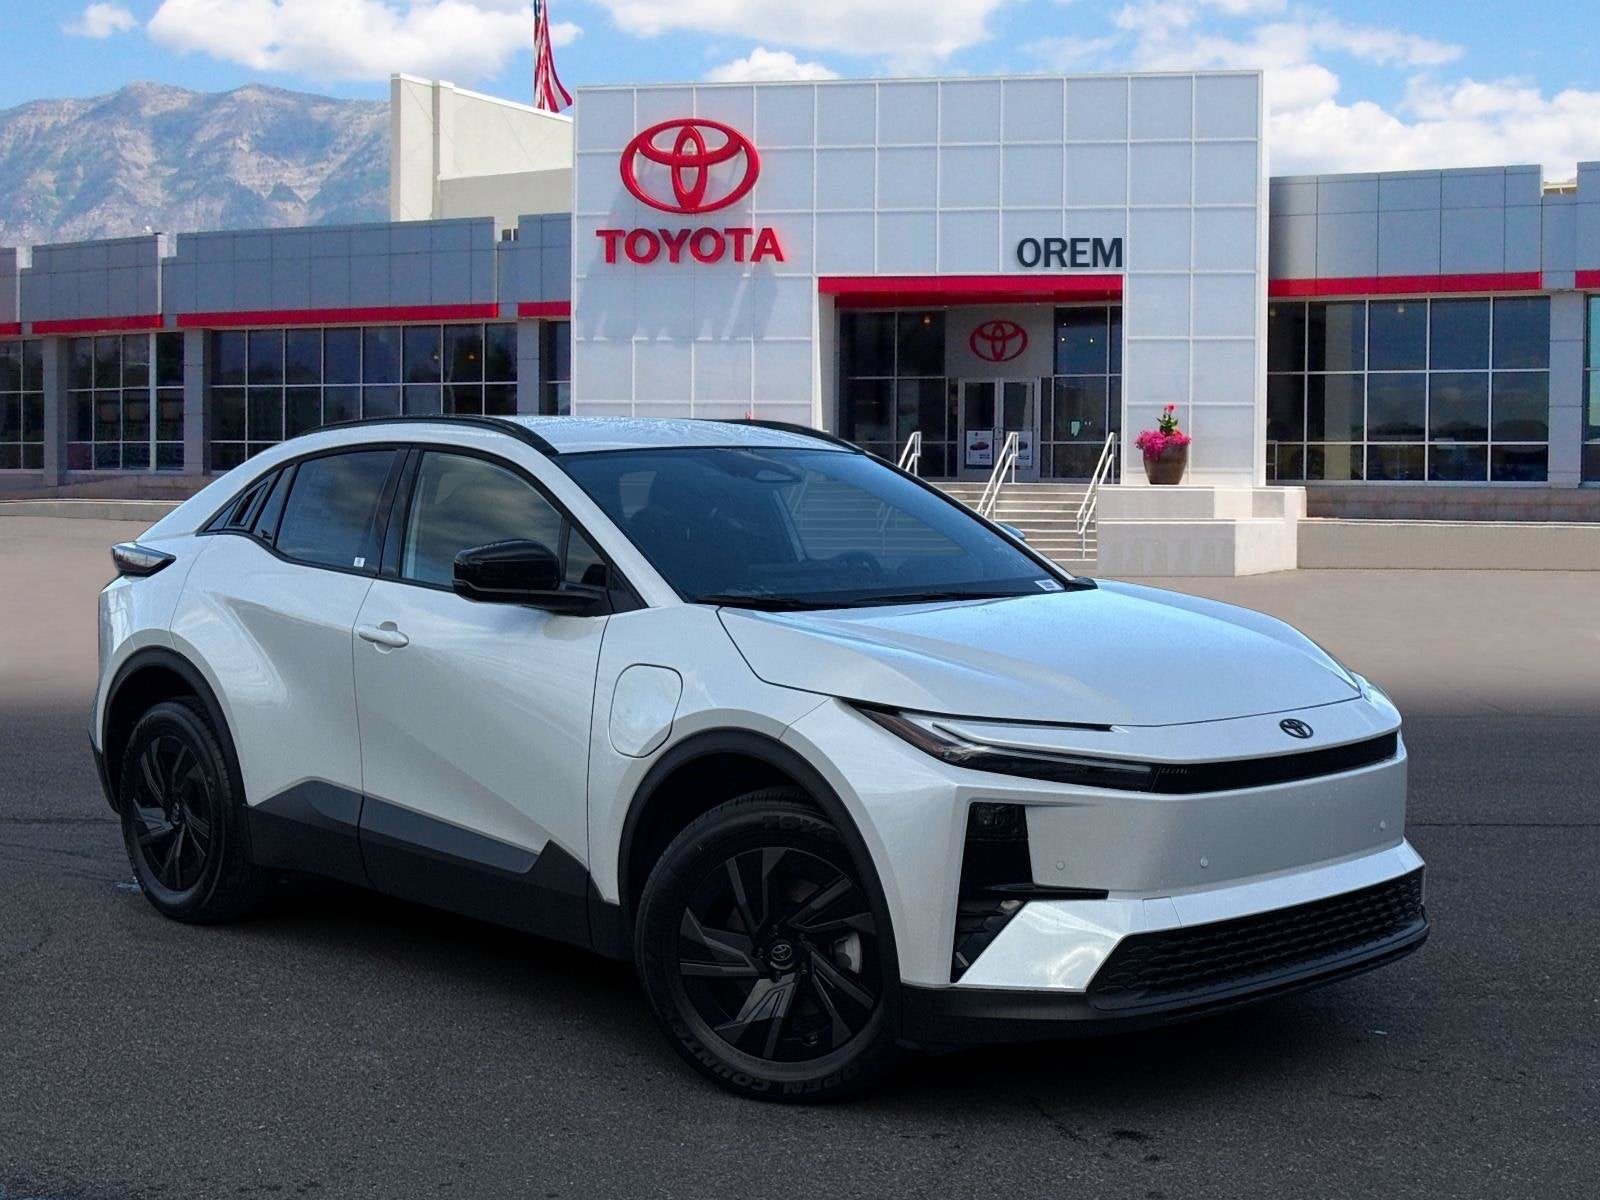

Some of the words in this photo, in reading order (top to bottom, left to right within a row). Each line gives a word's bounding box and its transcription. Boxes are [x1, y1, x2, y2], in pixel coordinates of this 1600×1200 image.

[596, 227, 784, 264] TOYOTA
[1017, 237, 1122, 268] OREM
[783, 1061, 861, 1096] OPEN
